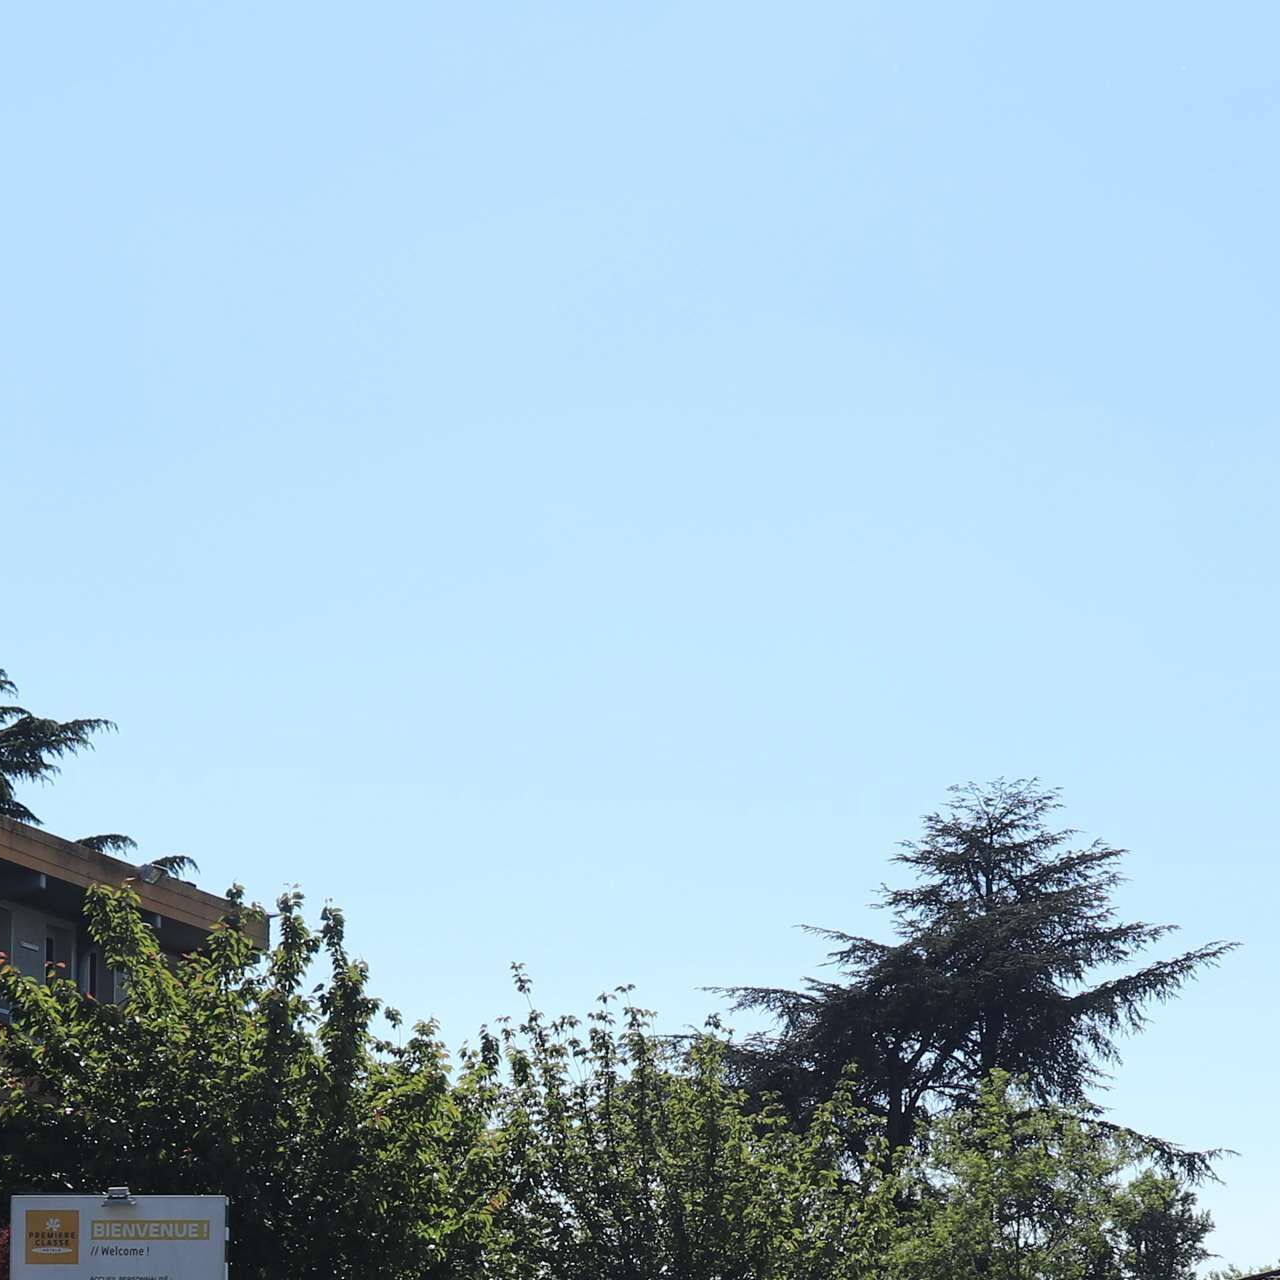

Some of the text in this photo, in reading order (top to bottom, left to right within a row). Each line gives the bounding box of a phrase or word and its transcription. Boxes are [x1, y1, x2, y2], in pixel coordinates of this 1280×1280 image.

[93, 1223, 198, 1237] BIENVENUE
[28, 1231, 76, 1239] PREMIERE
[34, 1239, 69, 1247] CLASSE
[101, 1246, 144, 1256] Welcome
